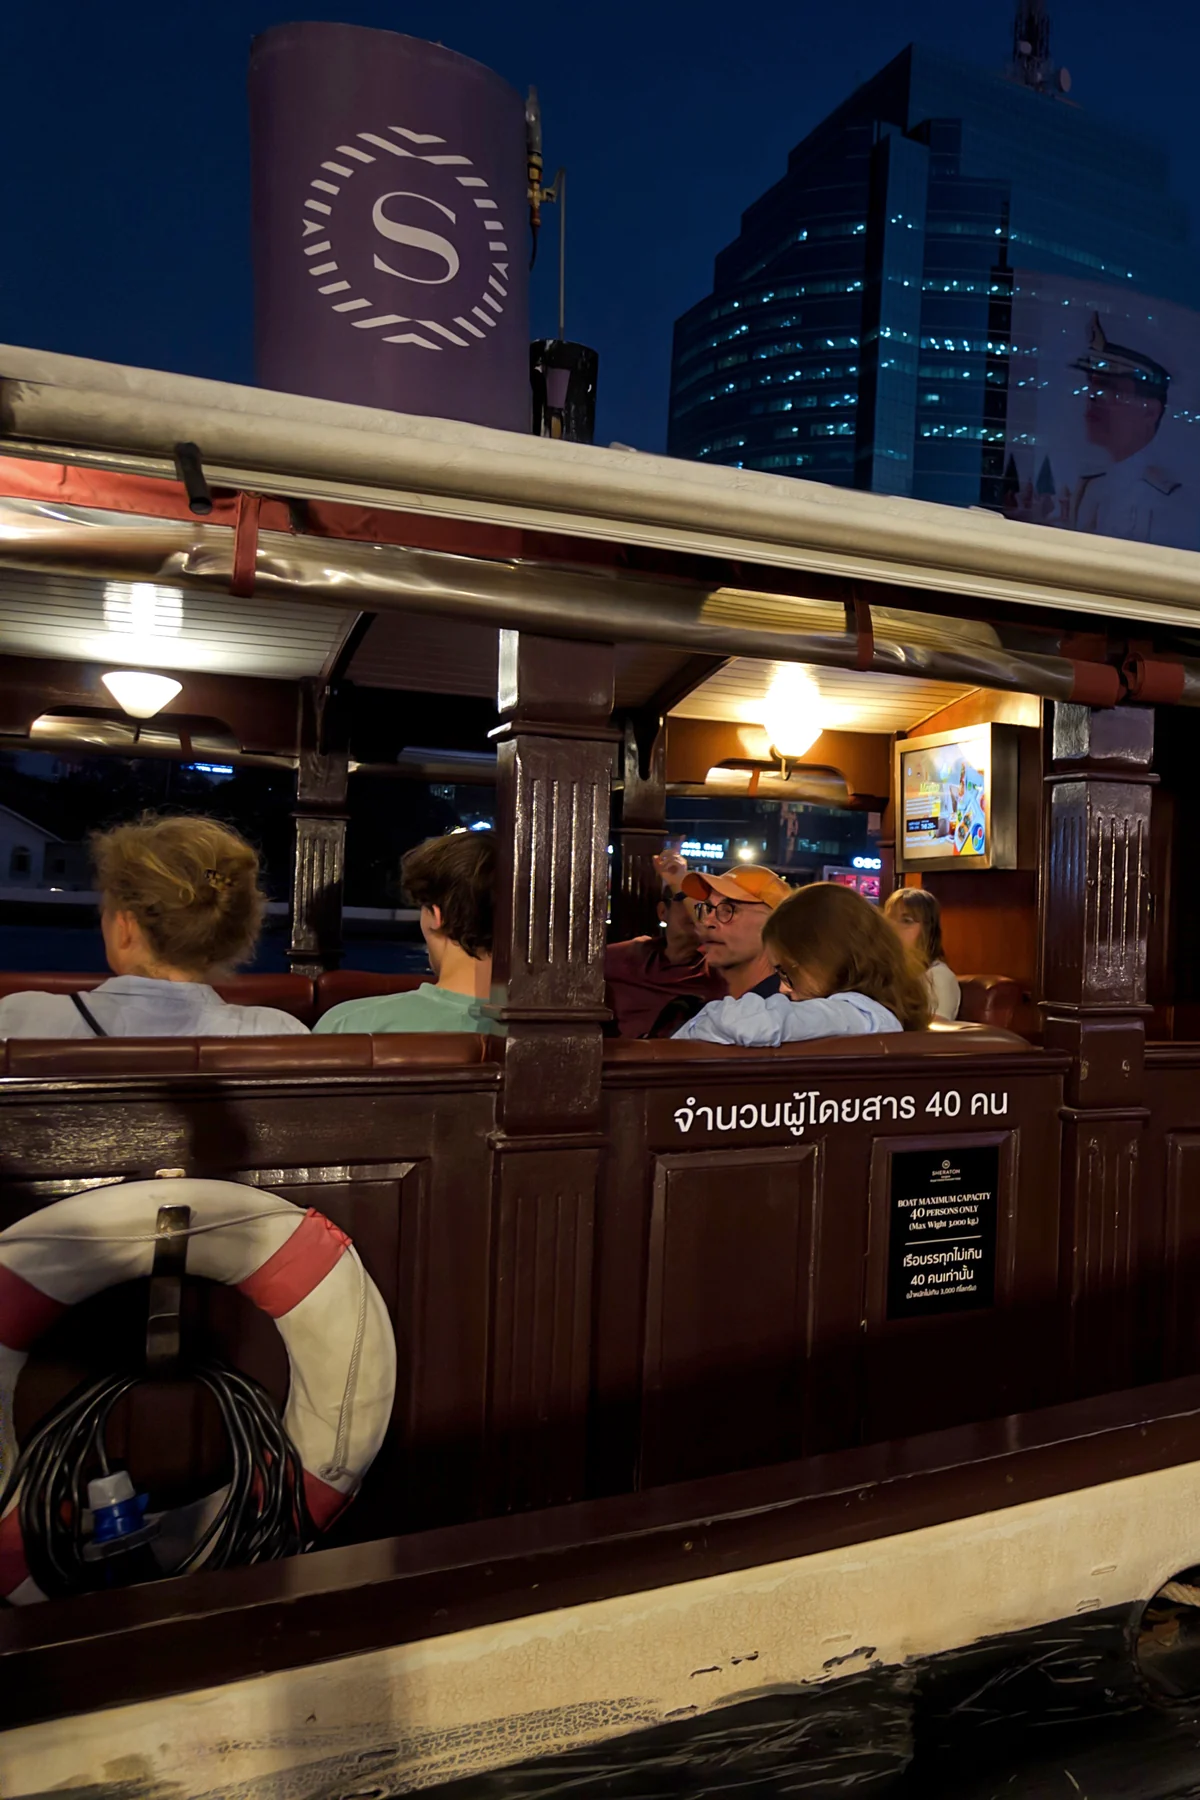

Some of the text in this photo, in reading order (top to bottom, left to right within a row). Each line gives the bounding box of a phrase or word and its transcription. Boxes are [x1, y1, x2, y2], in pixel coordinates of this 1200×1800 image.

[372, 191, 460, 285] S
[673, 1091, 1009, 1137] จำนวนผู้โดยสาร 40 คน
[897, 1192, 992, 1208] BOAT MAXIMUM CAPACITY
[910, 1204, 979, 1220] 40 PERSONS ONLY
[903, 1247, 983, 1267] เรือบรรทุกไม่เกิน
[910, 1265, 974, 1286] 40 คนเท่านั้น
